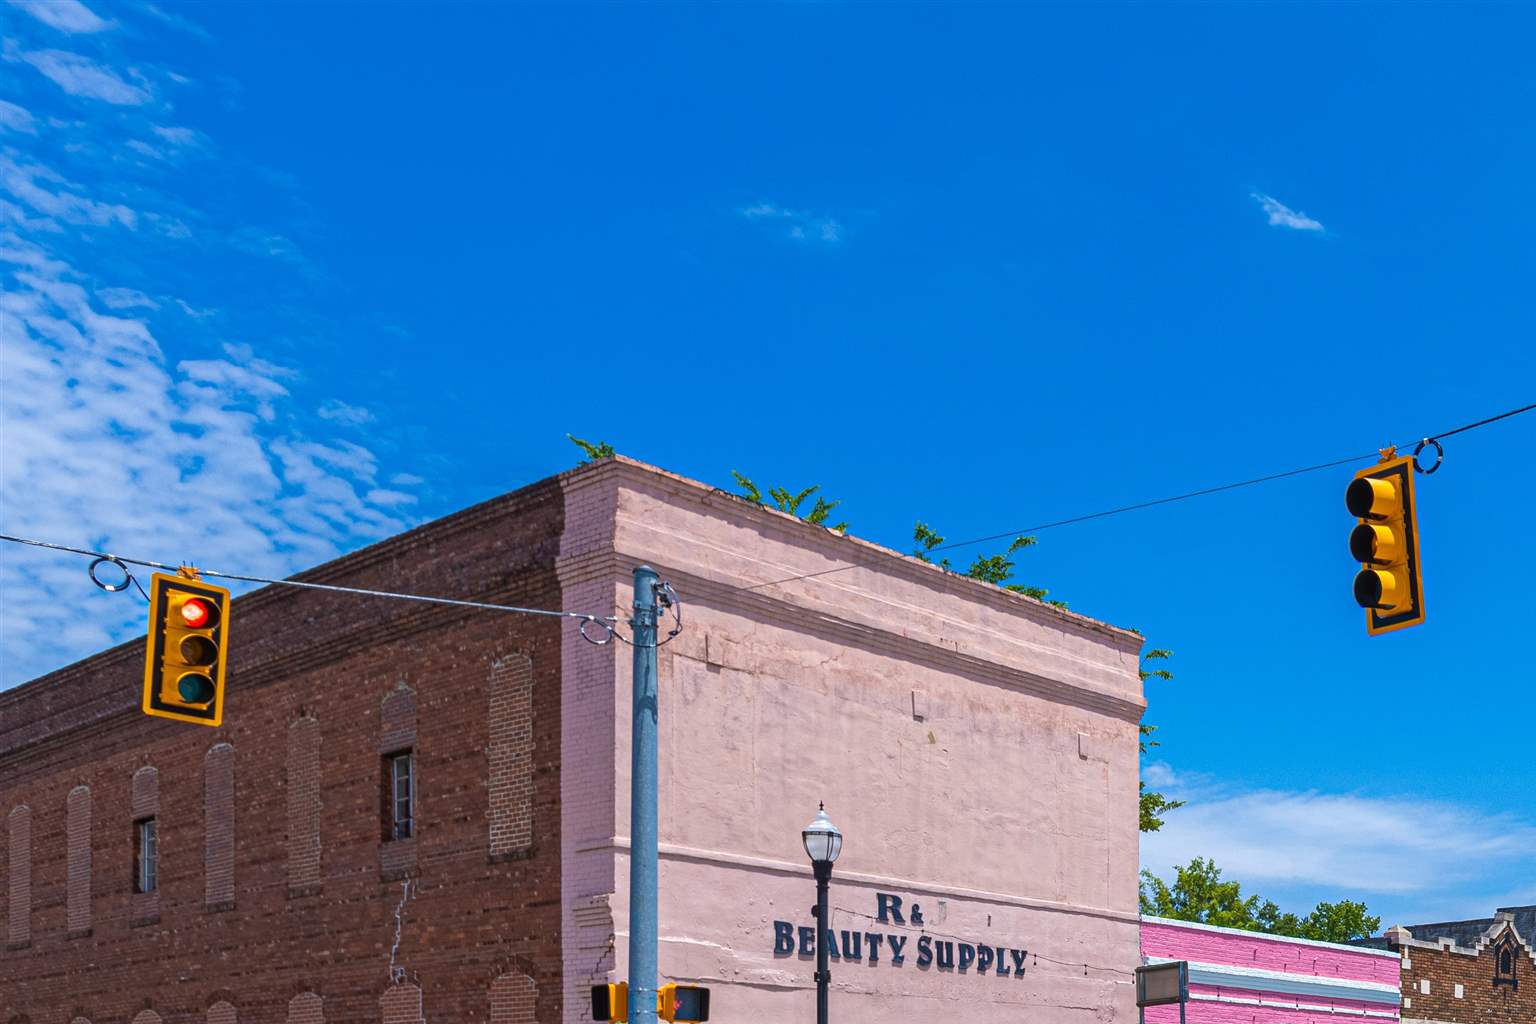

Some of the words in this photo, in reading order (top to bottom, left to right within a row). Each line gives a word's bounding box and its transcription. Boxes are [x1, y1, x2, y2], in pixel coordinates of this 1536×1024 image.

[875, 892, 905, 924] R
[910, 903, 924, 925] &
[773, 920, 907, 962] BEAUTY
[916, 935, 1028, 976] SUPPLY
